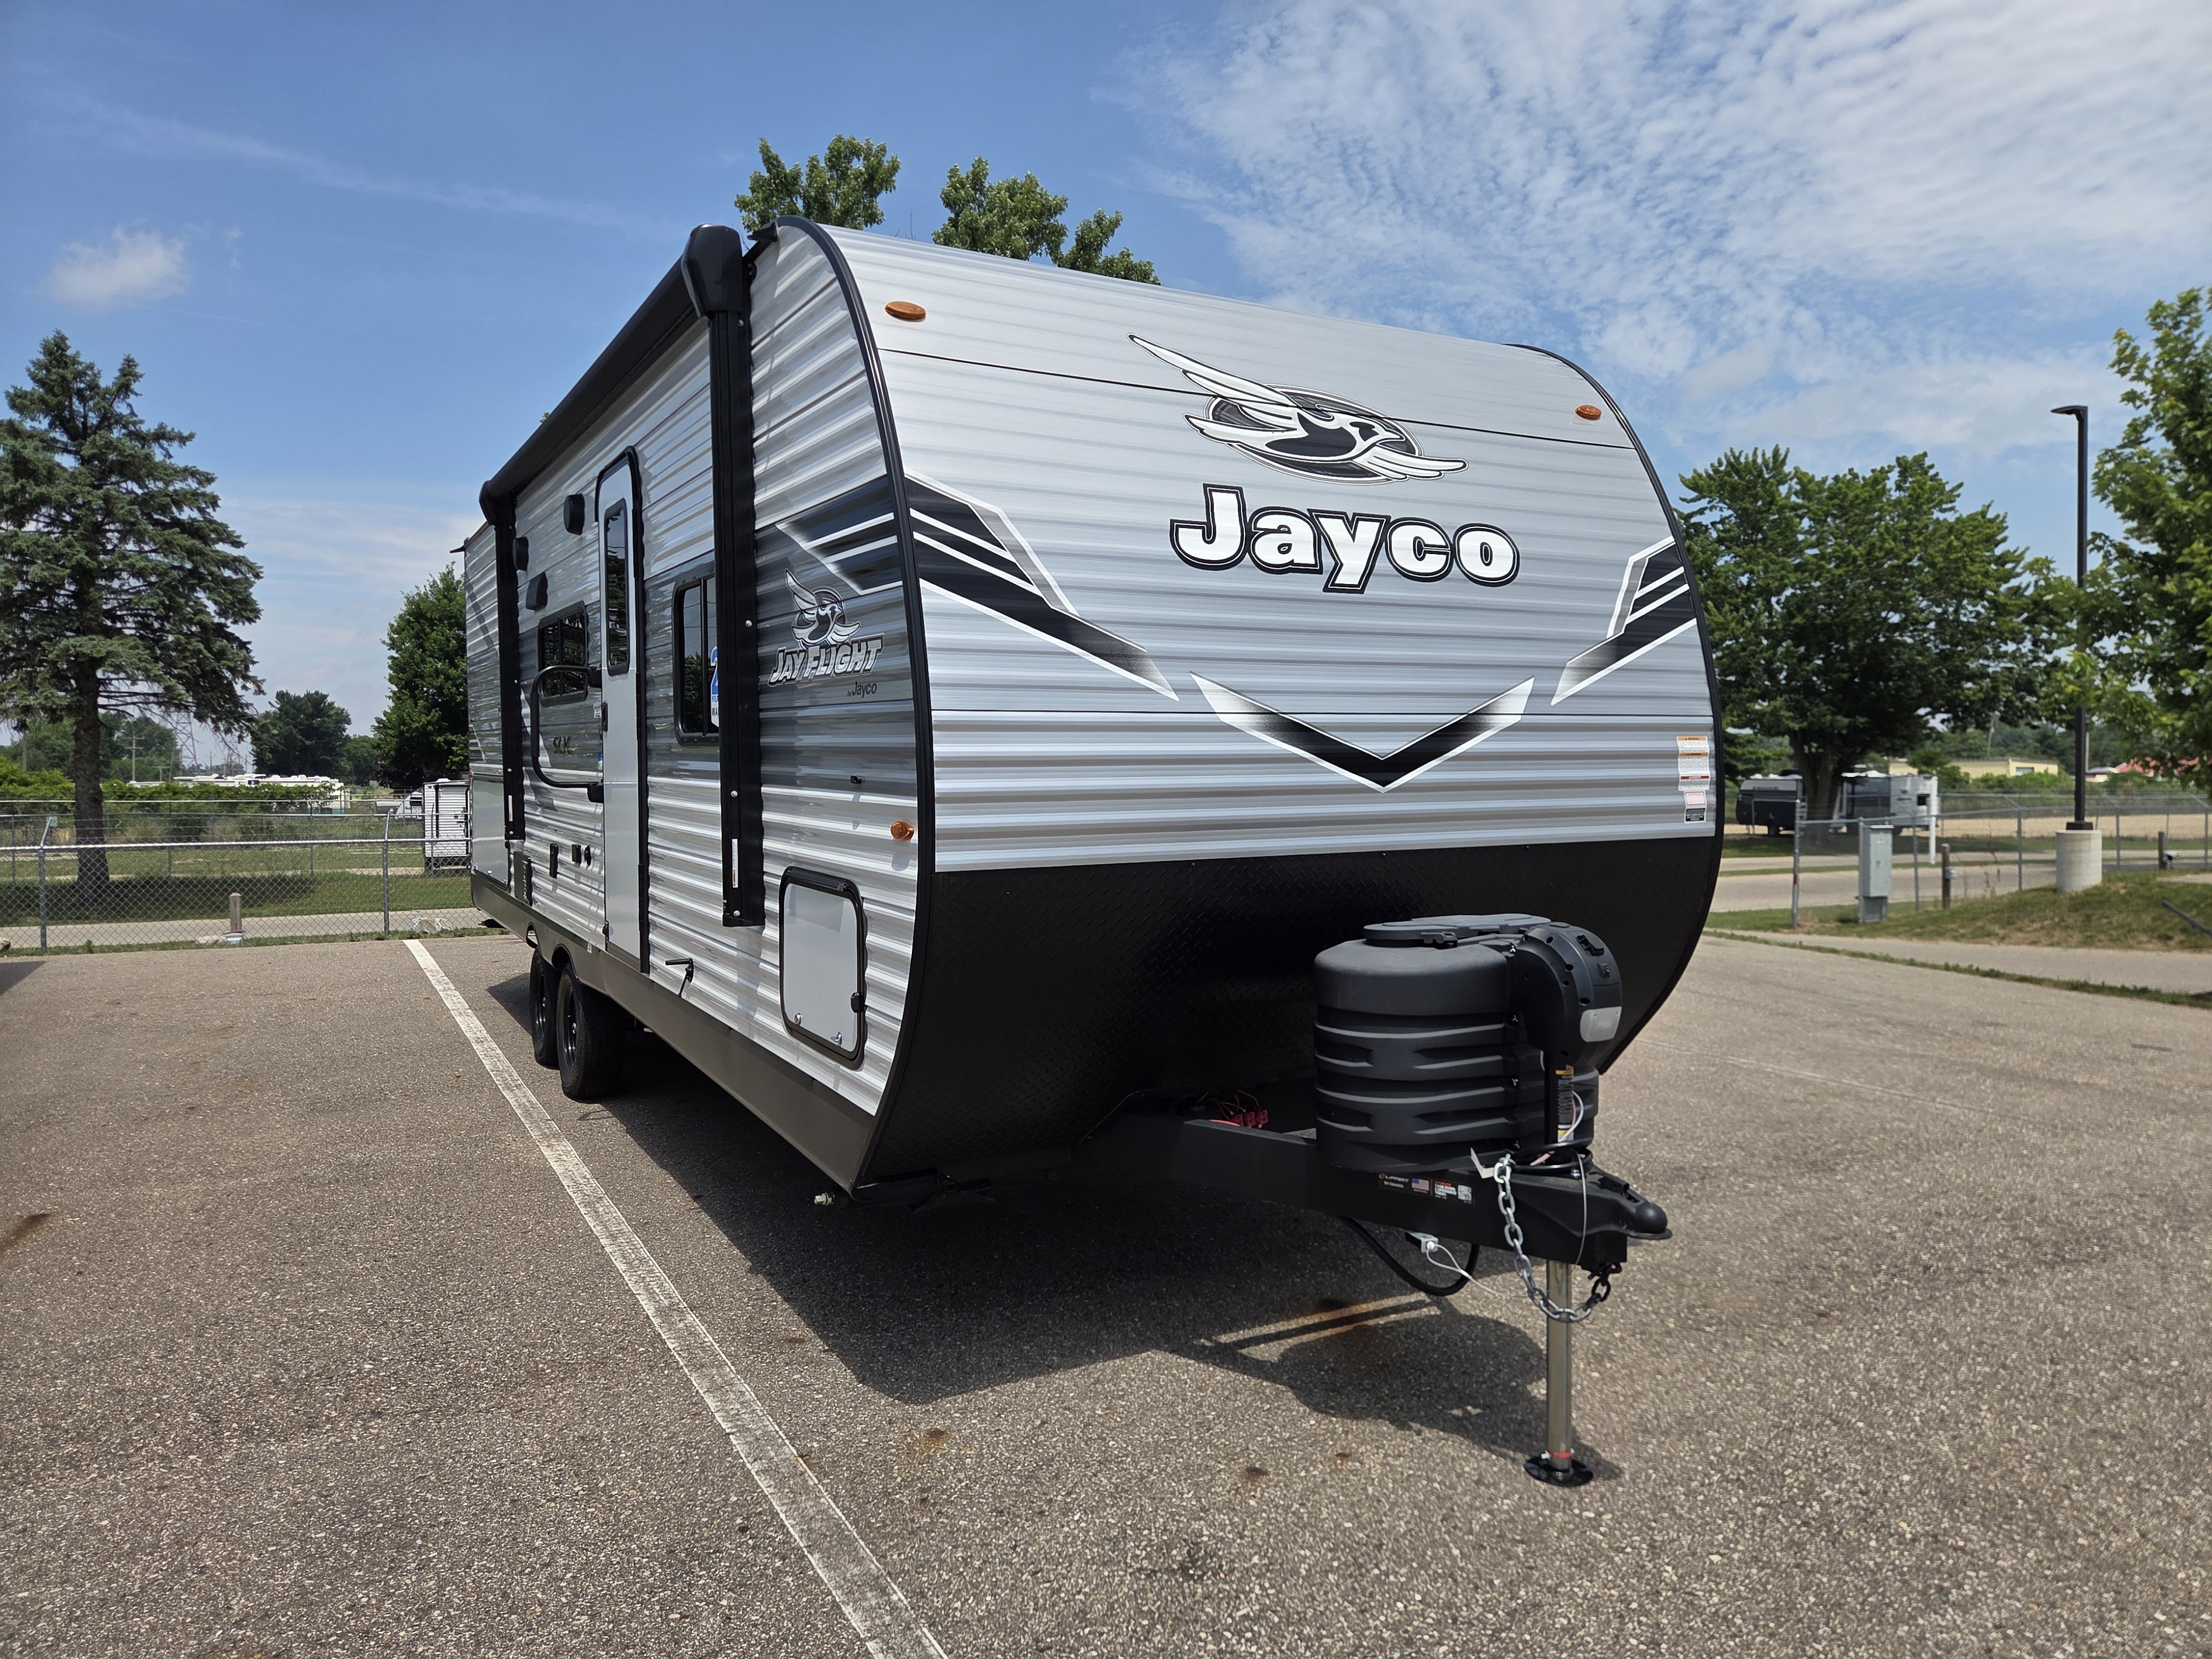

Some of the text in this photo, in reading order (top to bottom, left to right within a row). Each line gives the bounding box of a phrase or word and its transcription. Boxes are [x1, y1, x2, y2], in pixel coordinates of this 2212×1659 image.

[1170, 483, 1520, 594] Jayco
[769, 634, 884, 686] JAY FLIGHT
[852, 681, 878, 698] Jayco
